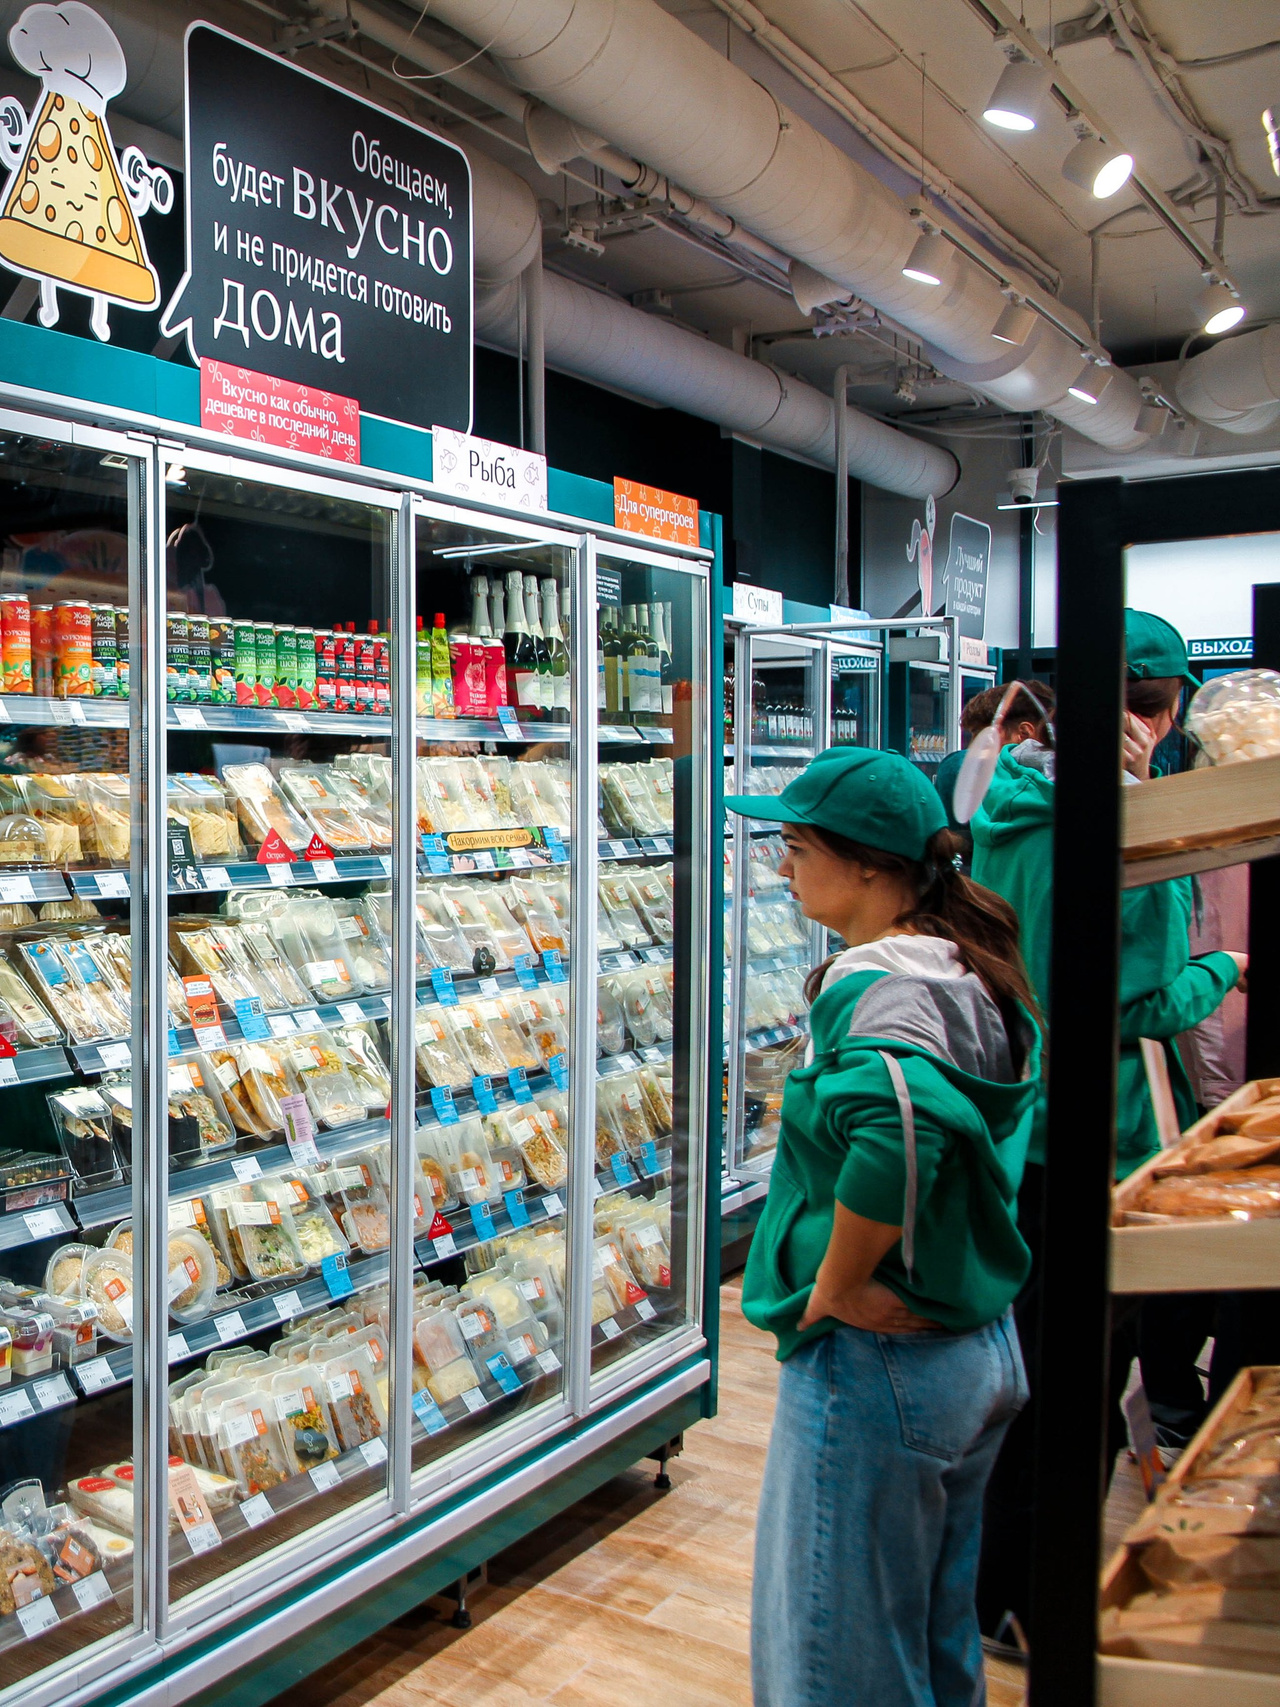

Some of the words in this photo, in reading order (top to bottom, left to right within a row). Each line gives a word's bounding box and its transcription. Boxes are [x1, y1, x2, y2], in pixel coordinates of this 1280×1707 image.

[212, 142, 285, 209] будет
[351, 130, 453, 220] Обещаем,
[214, 221, 228, 254] и
[237, 229, 264, 266] не
[272, 242, 368, 304] придется
[374, 280, 452, 334] готовить
[222, 378, 268, 406] Вкусно
[270, 395, 290, 412] как
[293, 400, 339, 426] обычно,
[205, 398, 258, 423] дешевле
[259, 412, 266, 424] в
[268, 413, 329, 440] последний
[331, 432, 357, 447] день
[469, 450, 517, 489] Рыба
[619, 494, 638, 514] Для
[639, 503, 694, 529] супергероев
[955, 546, 983, 574] Лучший
[747, 592, 769, 614] Супы
[954, 577, 983, 602] продукт
[1191, 640, 1253, 654] ВЫХОД
[266, 852, 286, 860] Острое
[450, 834, 490, 847] Накормим
[491, 834, 505, 844] всю
[506, 832, 528, 843] семью
